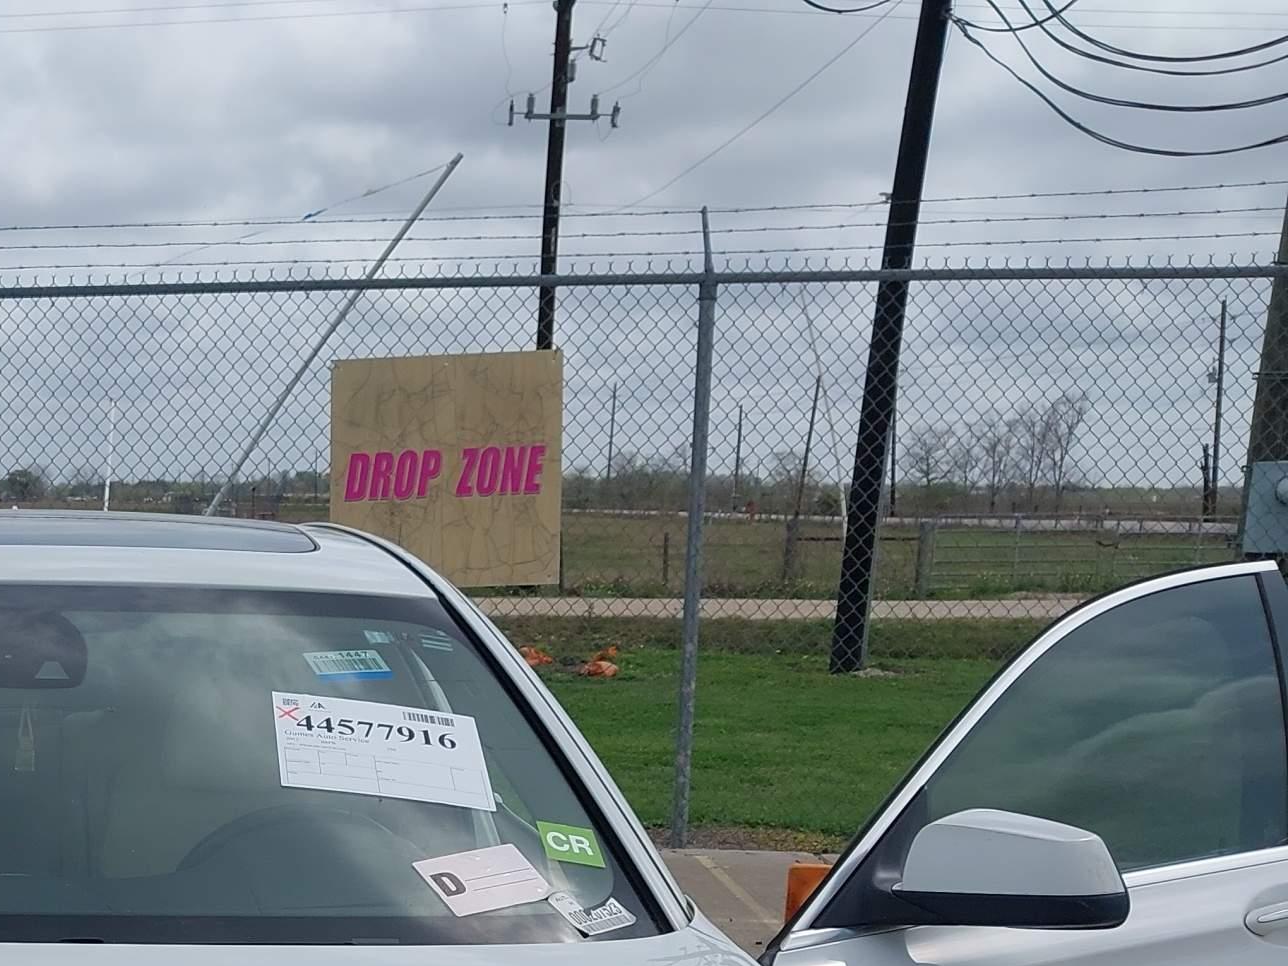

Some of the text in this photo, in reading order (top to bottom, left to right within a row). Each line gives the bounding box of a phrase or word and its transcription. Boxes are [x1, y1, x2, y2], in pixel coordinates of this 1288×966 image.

[344, 445, 547, 502] DROP ZONE
[296, 715, 457, 750] 44577916
[546, 830, 593, 856] CR
[429, 871, 467, 897] D
